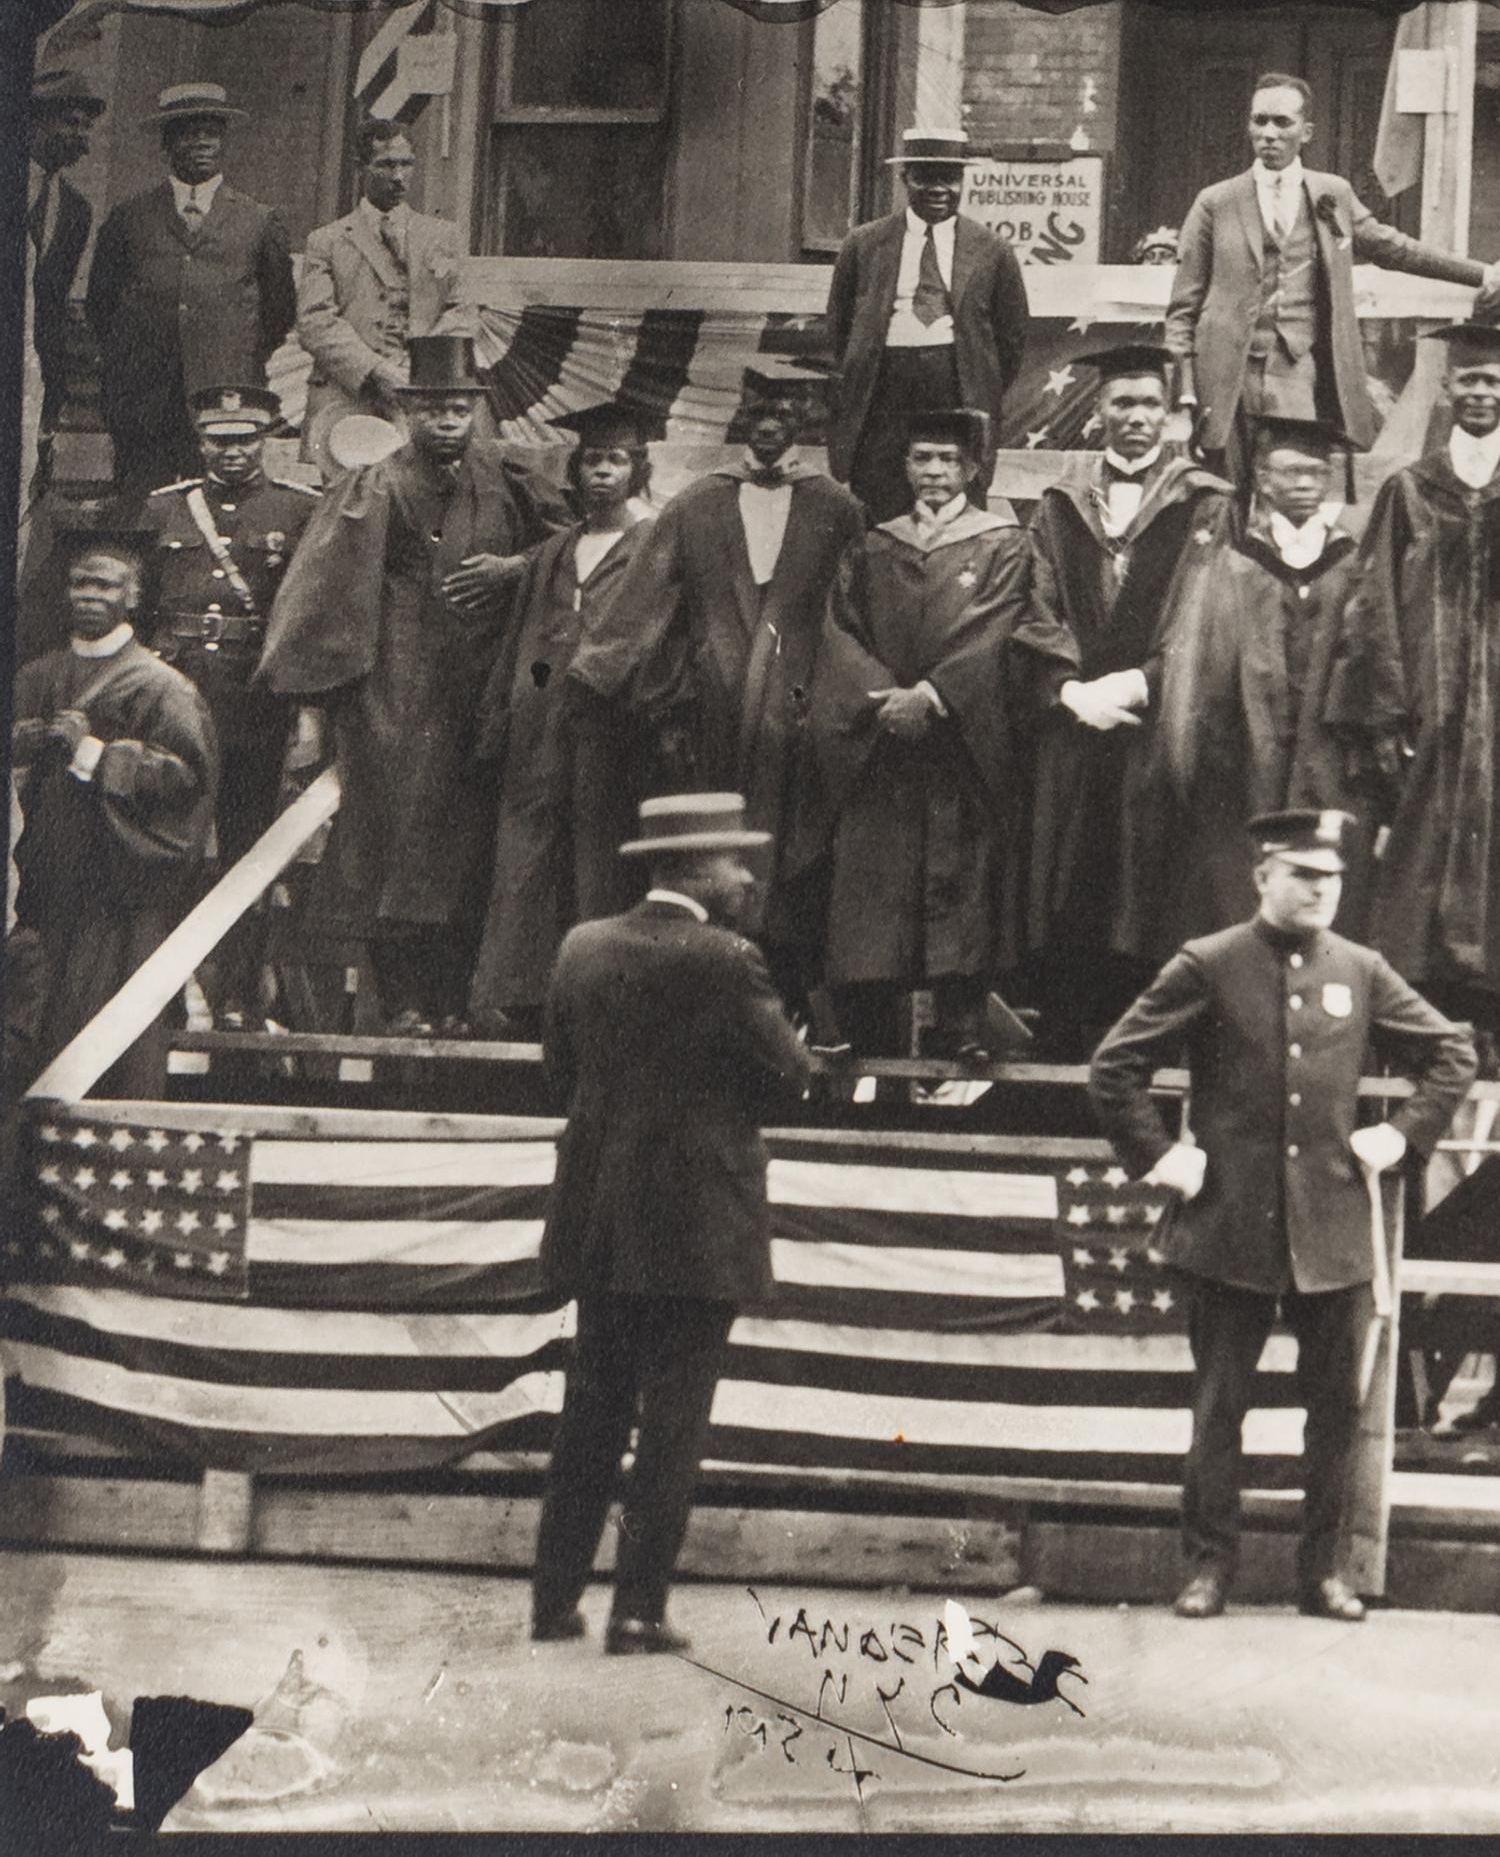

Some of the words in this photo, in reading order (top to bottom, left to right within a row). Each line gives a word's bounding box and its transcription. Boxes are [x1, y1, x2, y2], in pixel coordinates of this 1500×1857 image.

[973, 174, 1087, 188] UNIVERSAL
[969, 190, 1046, 205] PUBLISHING
[1052, 192, 1091, 206] HOUSE
[986, 221, 1032, 241] OB
[816, 1669, 962, 1751] NYC
